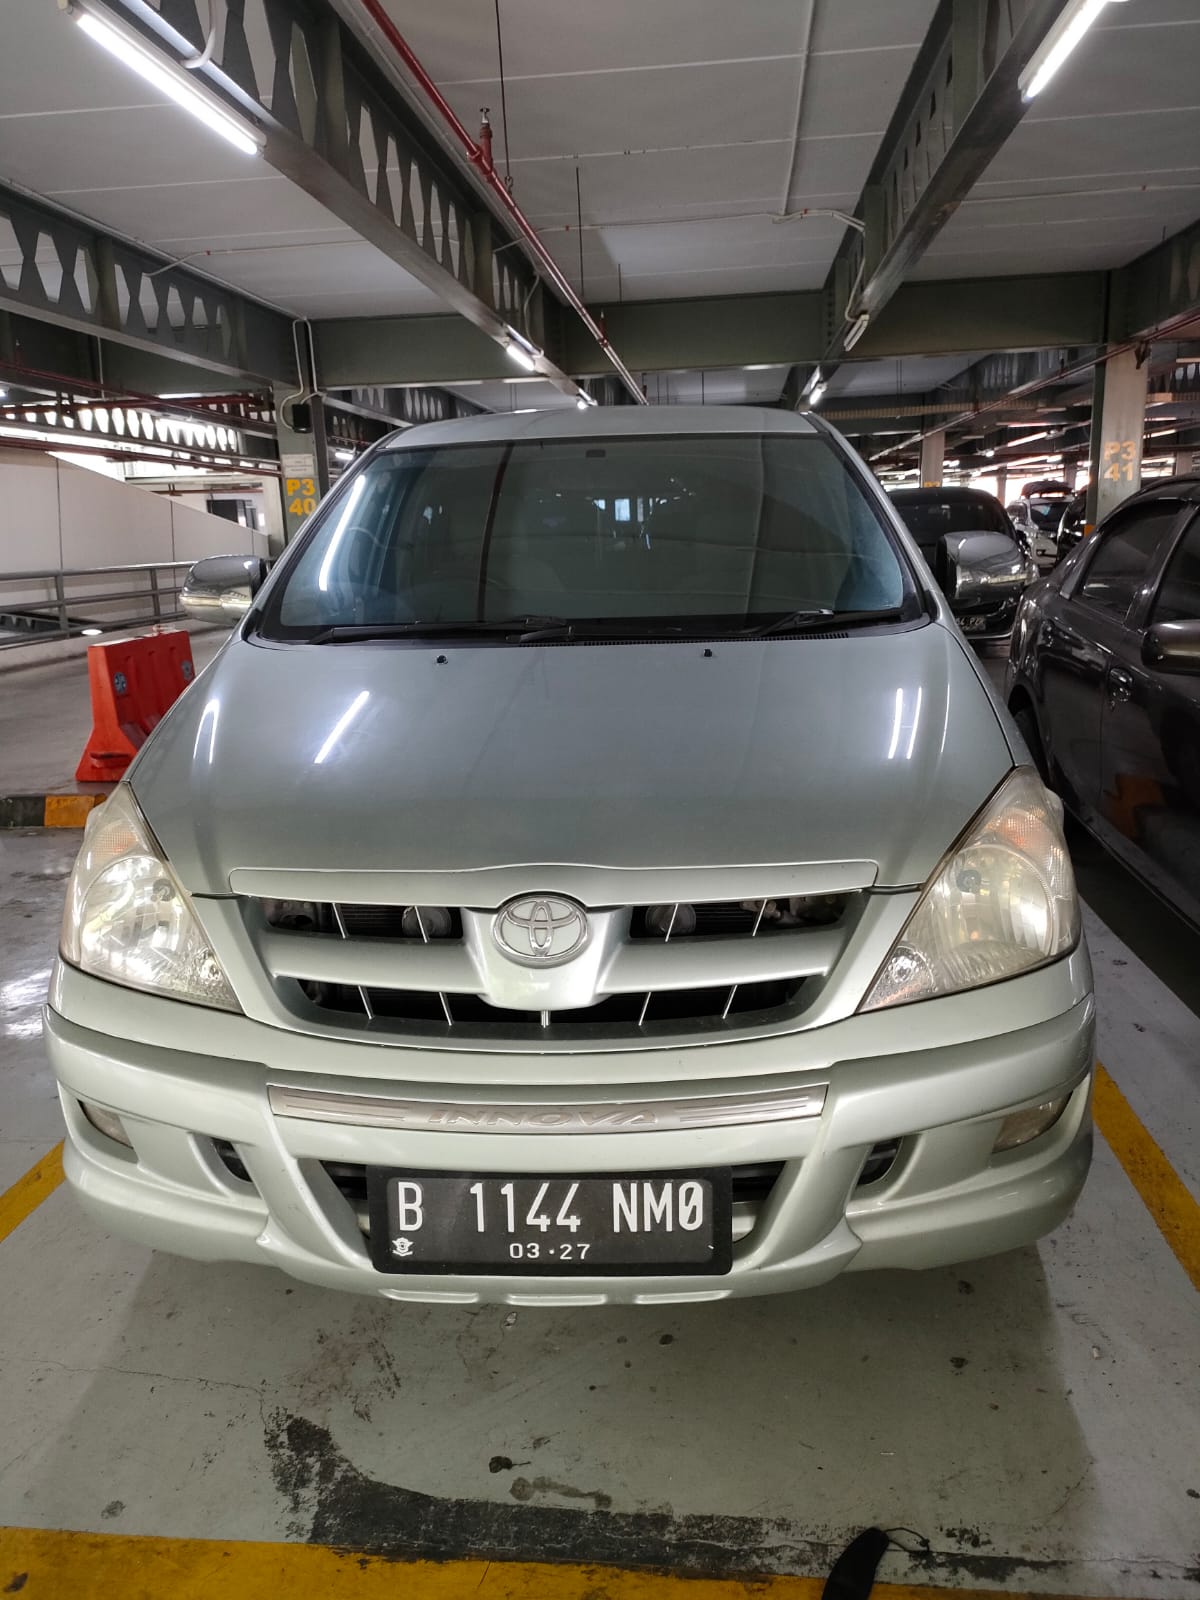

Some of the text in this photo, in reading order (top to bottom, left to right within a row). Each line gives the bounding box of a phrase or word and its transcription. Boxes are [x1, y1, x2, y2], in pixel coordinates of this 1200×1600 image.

[1104, 441, 1136, 461] P3
[1104, 462, 1133, 481] 41
[286, 478, 316, 497] P3
[289, 498, 317, 516] 40
[427, 1110, 659, 1127] INNOVA
[398, 1181, 424, 1232] B
[470, 1182, 582, 1233] 1144
